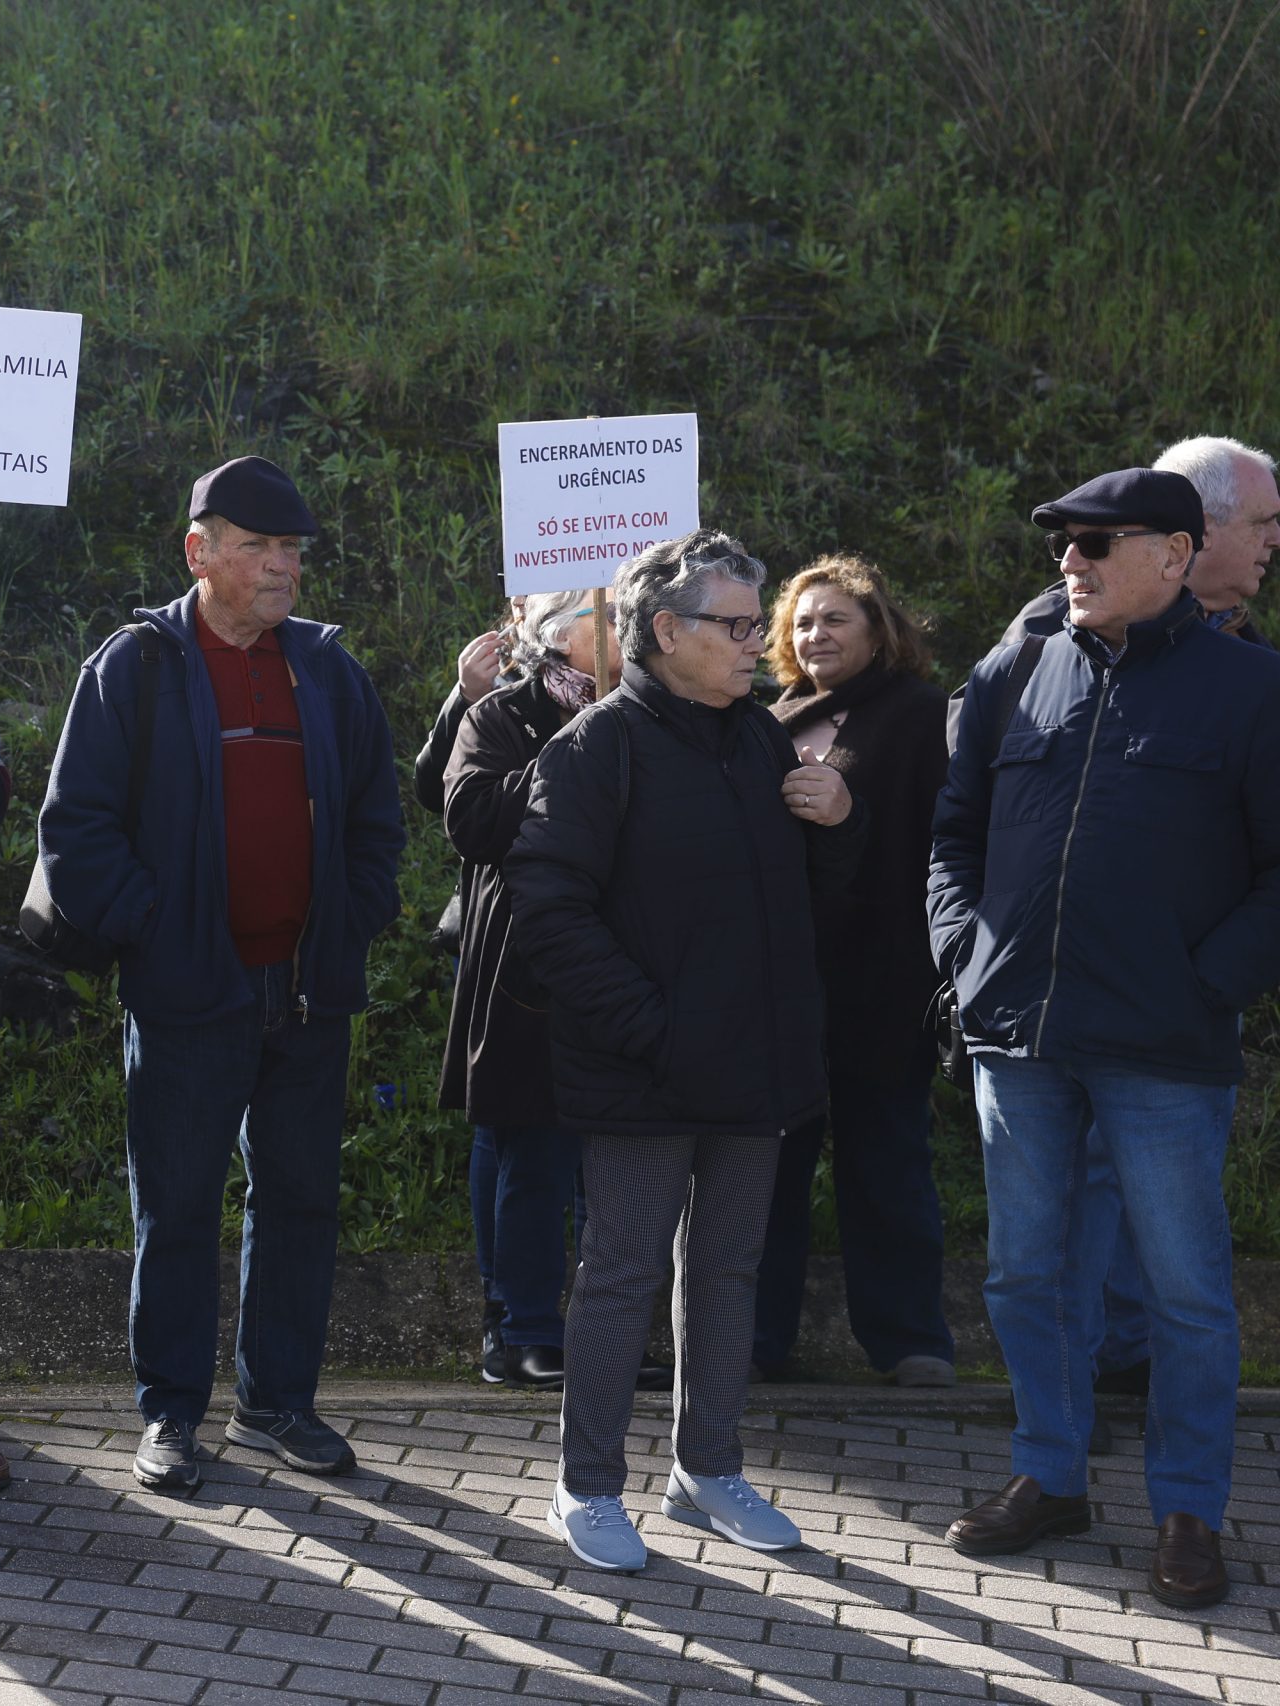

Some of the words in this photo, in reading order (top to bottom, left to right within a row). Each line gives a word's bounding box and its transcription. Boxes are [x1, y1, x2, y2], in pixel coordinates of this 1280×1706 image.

[520, 440, 647, 463] ENCERRAMENTO
[653, 438, 682, 453] DAS
[559, 468, 645, 489] URGÊNCIAS
[538, 516, 558, 536] SÓ
[563, 518, 579, 533] SE
[585, 514, 627, 531] EVITA
[632, 512, 667, 527] COM
[515, 543, 627, 567] INVESTIMENTO
